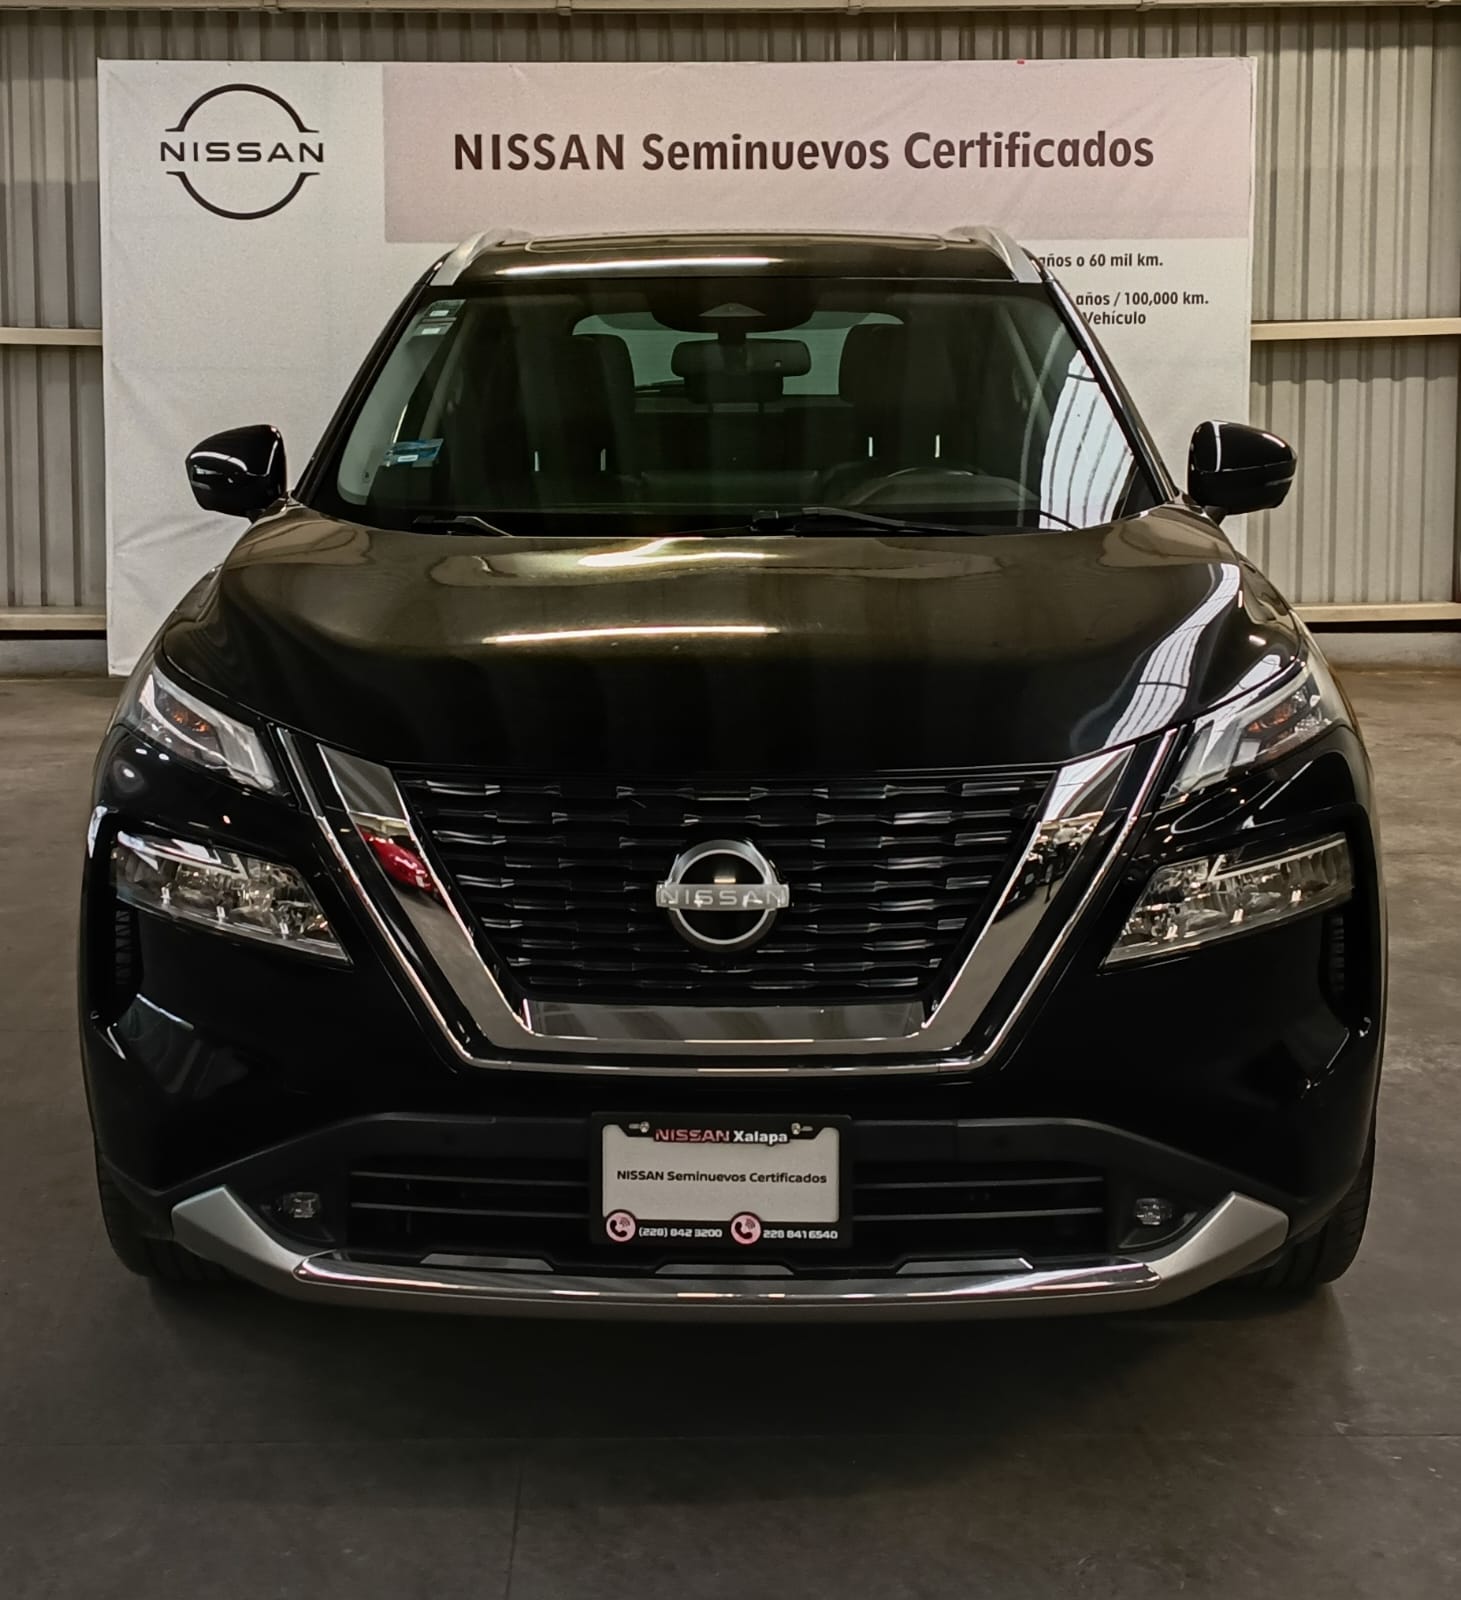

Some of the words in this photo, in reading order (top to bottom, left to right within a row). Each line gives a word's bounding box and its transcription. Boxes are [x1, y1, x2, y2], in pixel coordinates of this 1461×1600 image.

[160, 141, 324, 163] NISSAN
[454, 133, 624, 171] NISSAN
[642, 132, 889, 171] Seminuevos
[903, 130, 1154, 169] Certificados
[1076, 256, 1085, 267] o
[1089, 254, 1106, 267] 60
[1110, 253, 1132, 267] mil
[1137, 253, 1163, 266] km.
[1076, 292, 1110, 306] años
[1113, 291, 1120, 307] /
[1125, 291, 1178, 306] 100,000
[1183, 291, 1209, 305] km.
[1083, 310, 1146, 325] Vehículo
[660, 889, 786, 906] NISSAN
[655, 1129, 730, 1143] NISSAN
[733, 1130, 788, 1146] Xalapa
[617, 1170, 664, 1181] NISSAN
[667, 1170, 746, 1183] Seminuevos
[749, 1172, 827, 1184] Certificados
[638, 1227, 668, 1238] (228)
[670, 1228, 693, 1238] 842
[694, 1228, 723, 1238] 3200
[763, 1229, 784, 1239] 228
